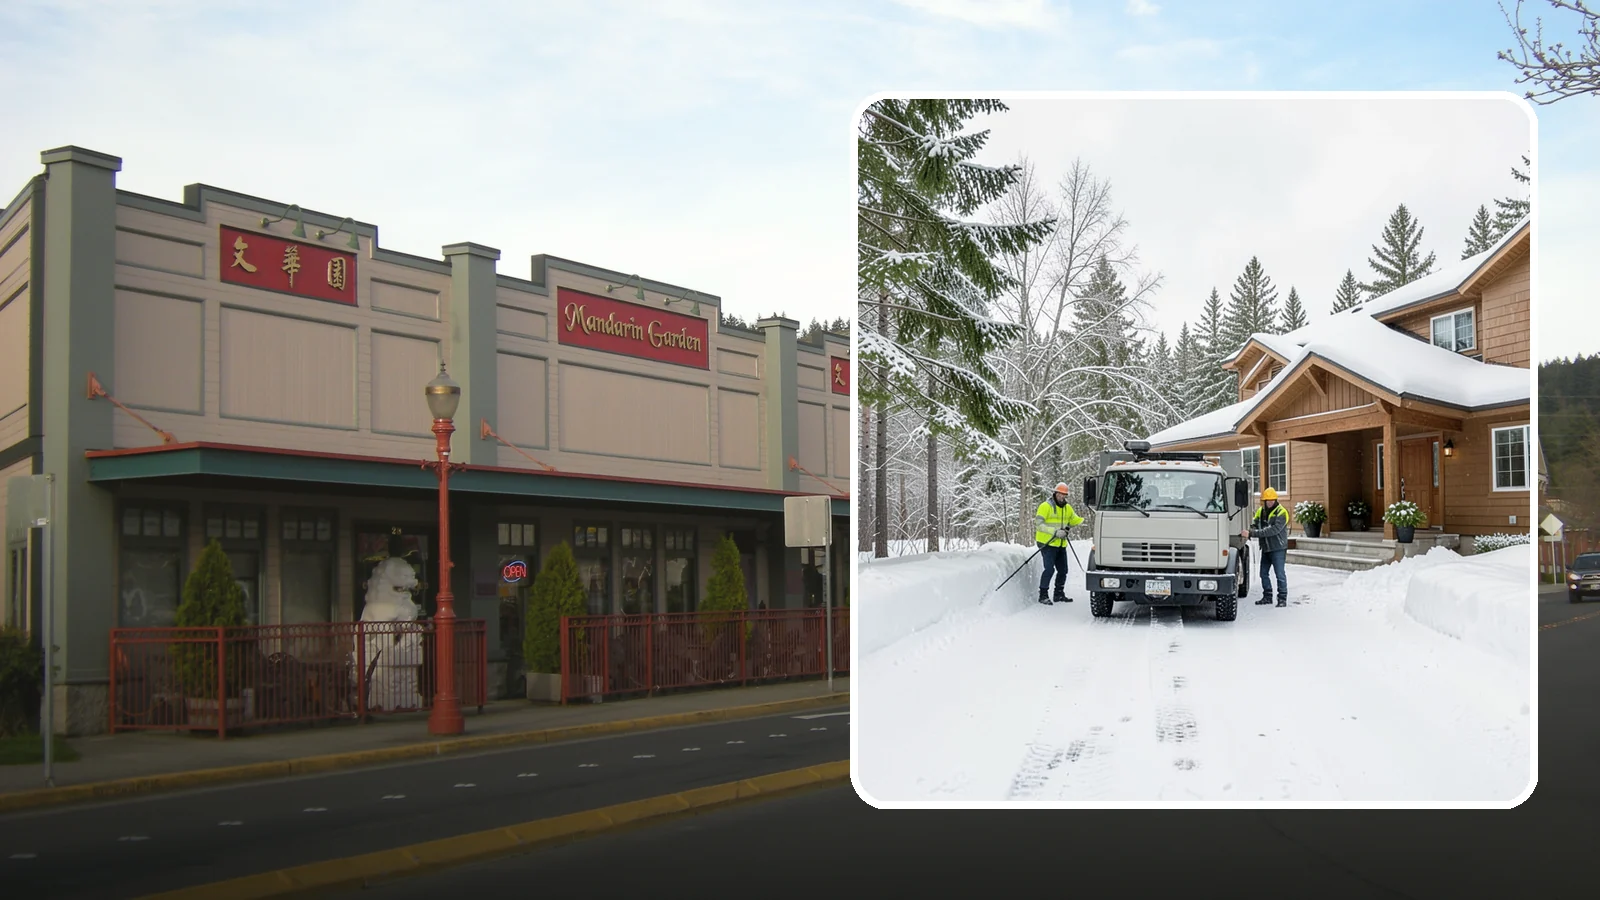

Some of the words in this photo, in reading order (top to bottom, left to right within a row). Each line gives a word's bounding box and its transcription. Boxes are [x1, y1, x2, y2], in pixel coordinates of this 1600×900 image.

[230, 235, 346, 291] 文華園
[564, 302, 644, 341] Mandarin
[647, 320, 702, 352] Garden
[503, 565, 527, 578] OPEN
